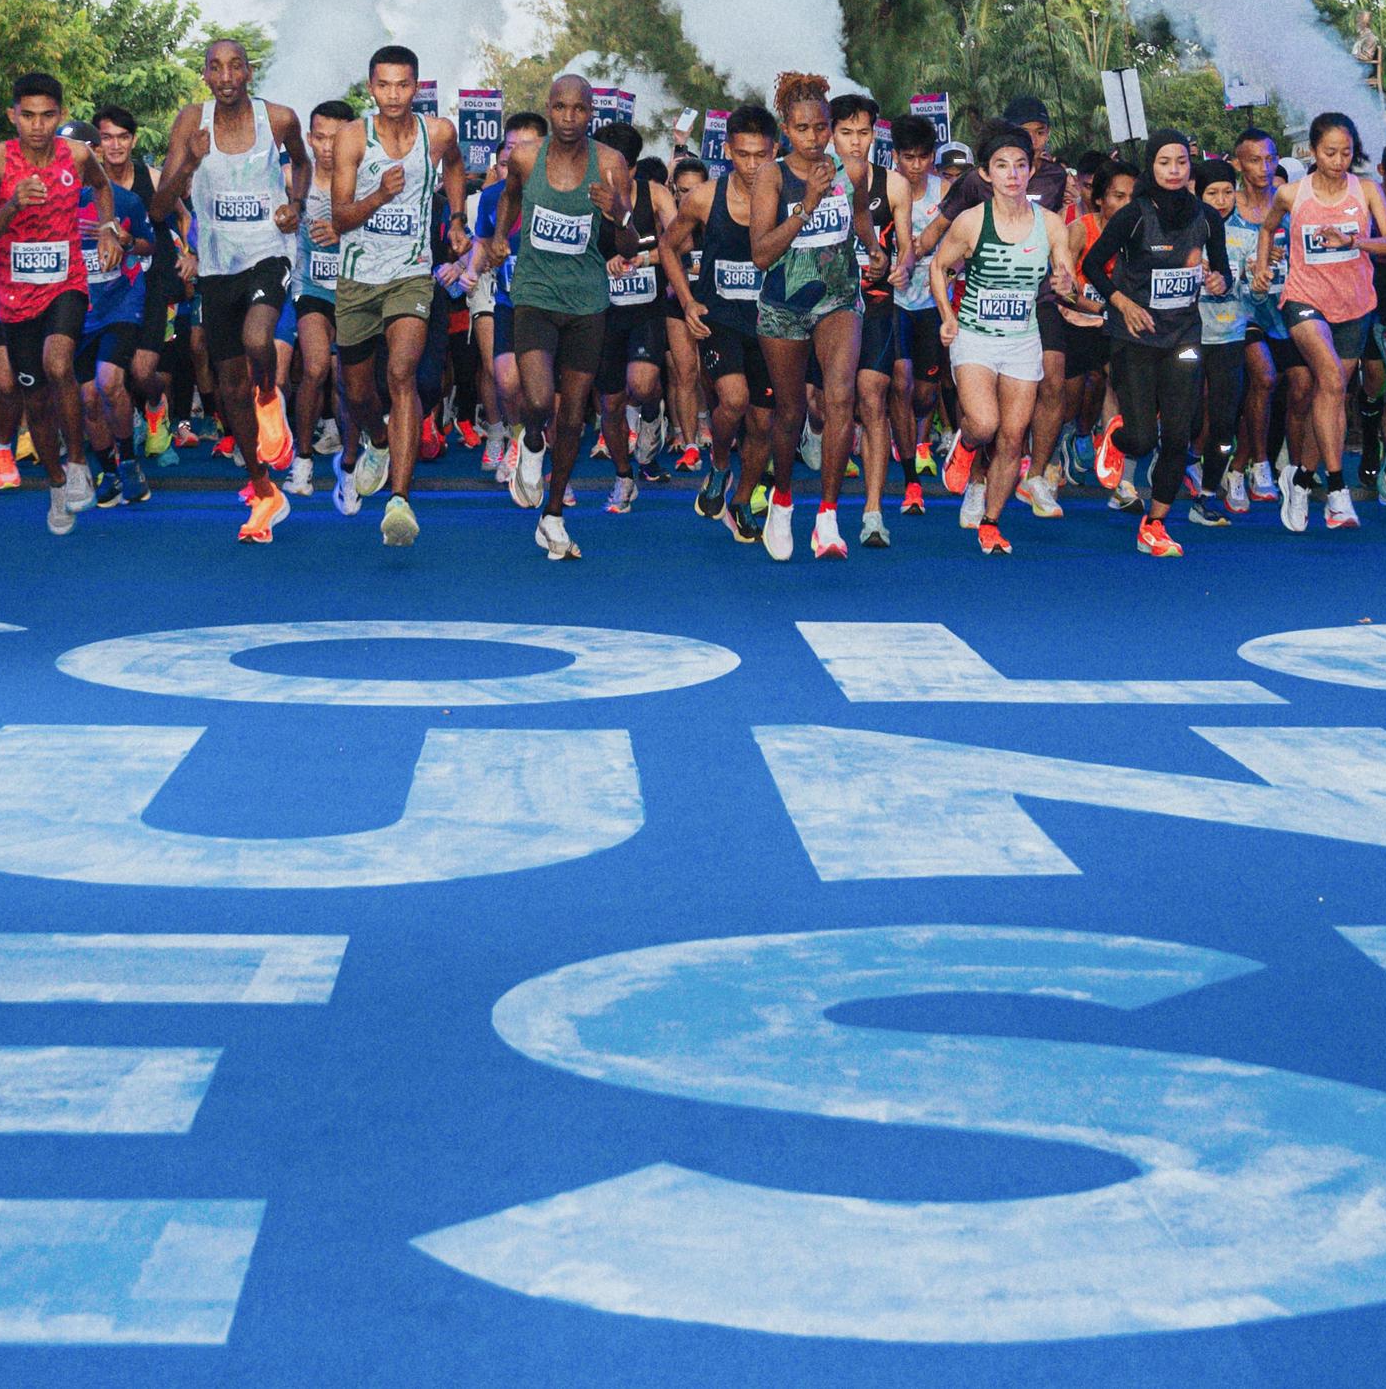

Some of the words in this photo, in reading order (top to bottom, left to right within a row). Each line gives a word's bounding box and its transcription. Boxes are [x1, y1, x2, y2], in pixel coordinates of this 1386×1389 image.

[464, 119, 498, 140] 1:00
[367, 214, 409, 232] H3823
[801, 209, 839, 232] 3578
[535, 219, 578, 241] G3744
[15, 252, 58, 268] H3306
[315, 262, 338, 276] H38
[609, 277, 645, 294] N9114
[723, 271, 755, 285] 3968
[1156, 277, 1194, 295] M2491
[981, 299, 1024, 316] M2015
